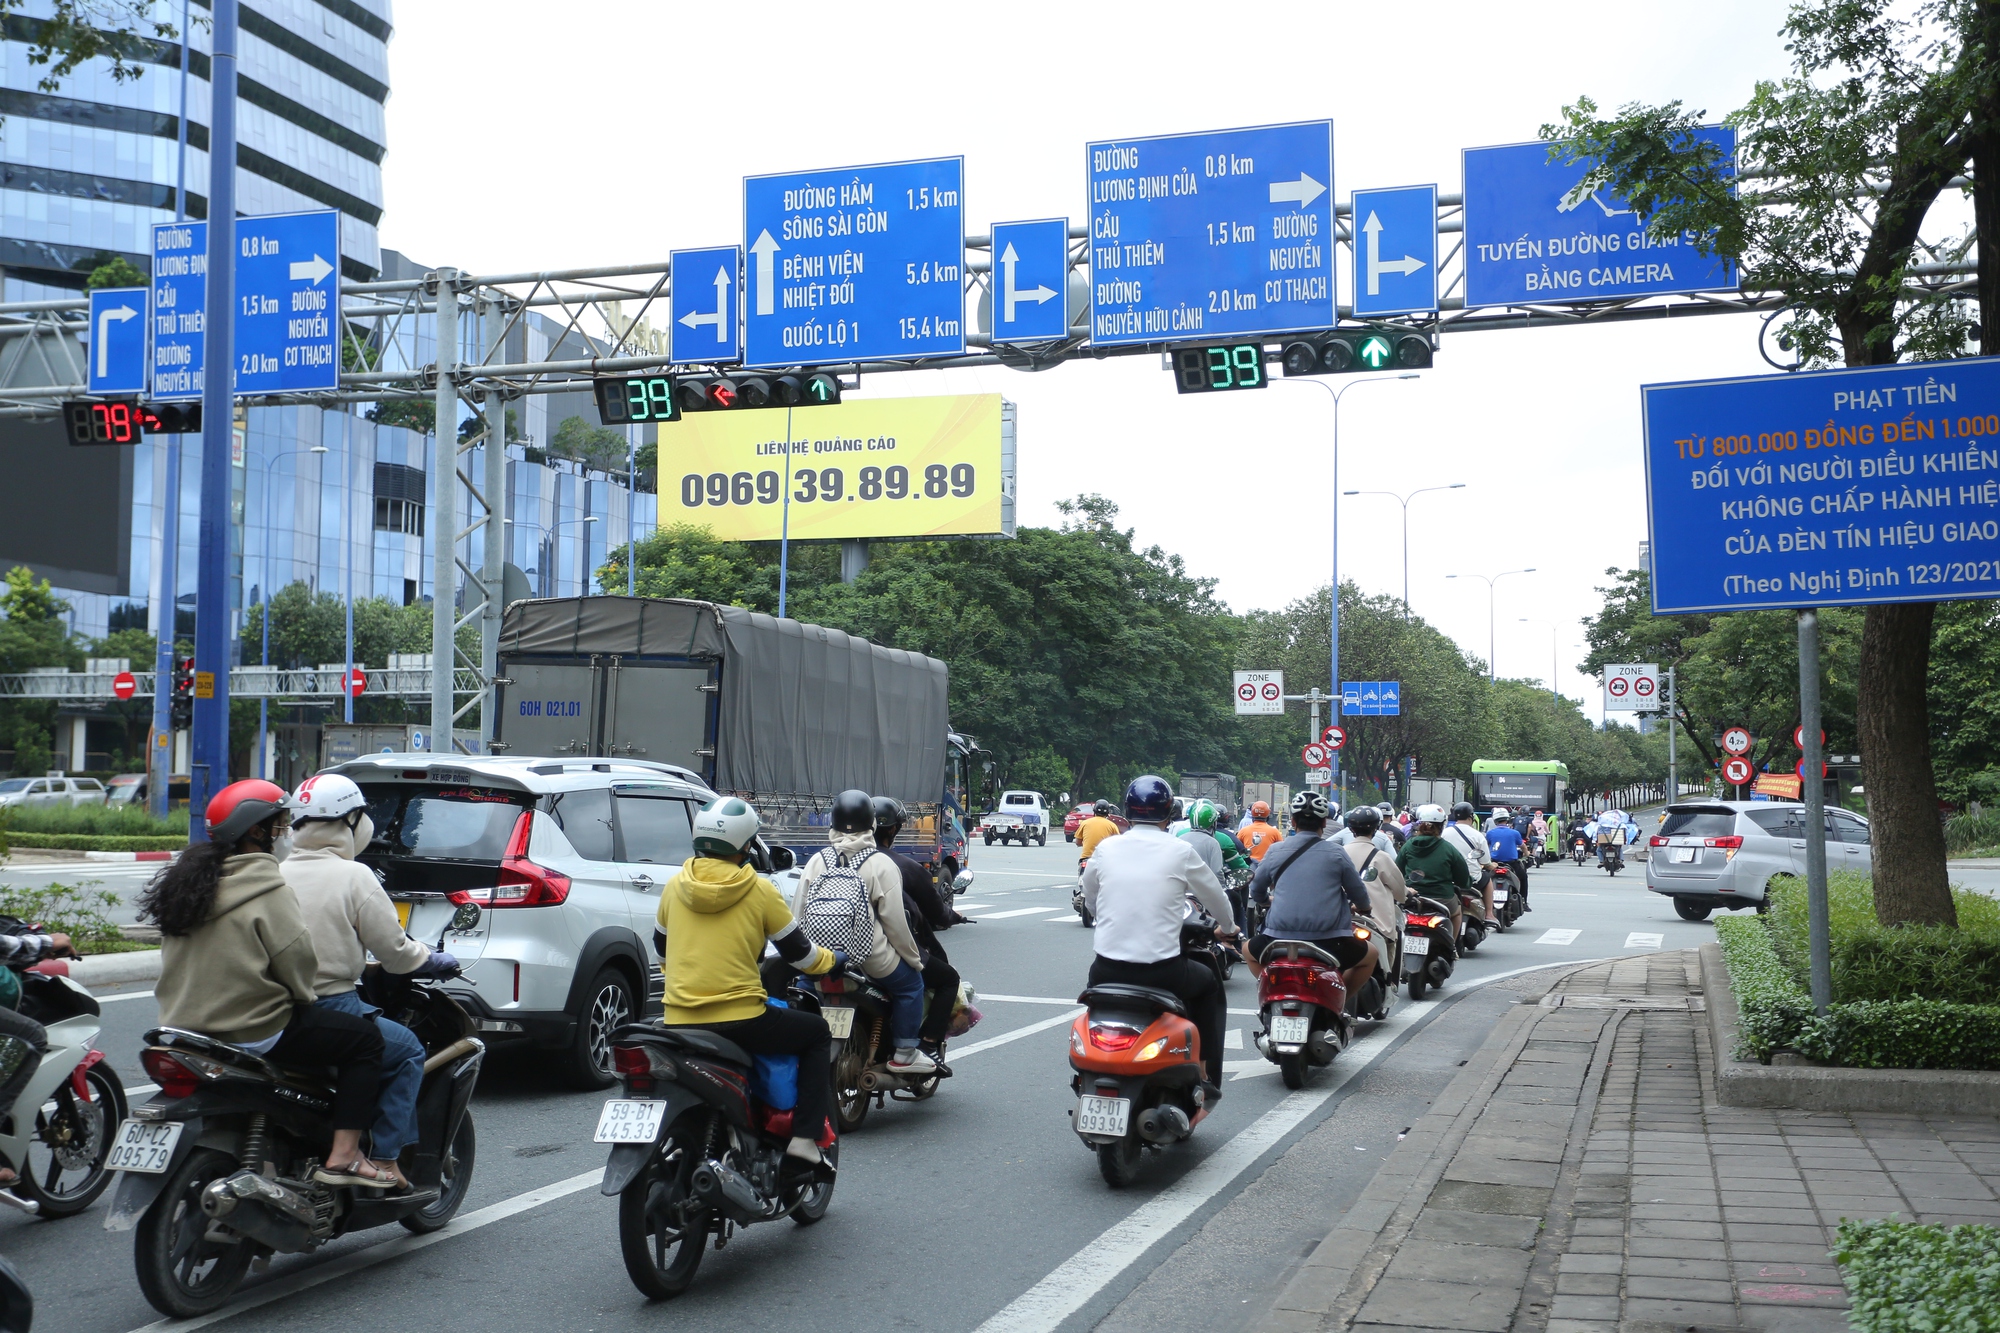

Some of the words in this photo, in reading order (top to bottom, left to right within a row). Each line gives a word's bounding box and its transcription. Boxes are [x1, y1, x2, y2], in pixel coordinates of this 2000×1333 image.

[1094, 146, 1138, 173] ĐƯỜNG
[1204, 154, 1227, 179] 0,8
[1230, 153, 1254, 176] km
[783, 183, 836, 212] ĐƯỜNG
[840, 176, 874, 207] HẦM
[906, 188, 930, 211] 1,5
[932, 187, 958, 208] km
[1094, 178, 1136, 204] LƯƠNG
[1138, 174, 1169, 202] ĐỊNH
[1172, 167, 1198, 197] CỦA
[782, 212, 823, 240] SÔNG
[828, 210, 852, 237] SÀI
[856, 208, 888, 235] GÒN
[1095, 209, 1120, 240] CẦU
[1206, 222, 1229, 247] 1,5
[1232, 222, 1256, 244] km
[1272, 210, 1318, 240] ĐƯỜNG
[157, 225, 192, 250] ĐƯỜNG
[242, 236, 259, 257] 0,8
[260, 236, 279, 255] km
[1096, 240, 1121, 270] THỦ
[1124, 238, 1164, 267] THIÊM
[1269, 240, 1321, 271] NGUYỄN
[1477, 233, 1542, 262] TUYẾN
[1548, 232, 1620, 257] ĐƯỜNG
[156, 255, 189, 278] LƯƠNG
[190, 254, 207, 276] ĐỊN
[783, 254, 824, 282] BỆNH
[828, 250, 864, 278] VIỆN
[906, 262, 930, 285] 5,6
[932, 262, 958, 284] km
[1525, 264, 1582, 292] BẰNG
[1588, 262, 1674, 286] CAMERA
[156, 281, 176, 308] CẦU
[242, 296, 259, 316] 1,5
[260, 296, 279, 314] km
[291, 286, 327, 312] ĐƯỜNG
[783, 283, 826, 310] NHIỆT
[828, 277, 854, 305] ĐỚI
[1096, 276, 1142, 306] ĐƯỜNG
[1208, 290, 1230, 315] 2,0
[1233, 290, 1257, 312] km
[1264, 280, 1283, 304] CƠ
[1285, 276, 1327, 305] THẠCH
[156, 310, 176, 335] THỦ
[178, 309, 206, 334] THIÊ
[288, 312, 328, 340] NGUYỄN
[782, 318, 823, 348] QUỐC
[828, 320, 848, 348] LỘ
[852, 322, 859, 343] 1
[898, 318, 931, 340] 15,4
[932, 316, 959, 338] km
[1096, 302, 1142, 336] NGUYỄN
[1146, 304, 1169, 334] HỮU
[1172, 302, 1203, 331] CẢNH
[156, 340, 192, 366] ĐƯỜNG
[242, 354, 259, 375] 2,0
[260, 354, 278, 372] km
[284, 348, 299, 367] CƠ
[300, 344, 332, 368] THẠCH
[1207, 346, 1260, 388] 39
[156, 366, 191, 393] NGUYỄN
[1834, 388, 1896, 412] PHẠT
[1901, 376, 1957, 405] TIỀN
[626, 378, 672, 420] 39
[92, 403, 132, 442] 79
[1674, 433, 1706, 460] TỪ
[1712, 430, 1798, 457] 800.000
[1804, 418, 1875, 449] ĐỒNG
[1882, 412, 1935, 442] ĐẾN
[756, 440, 786, 456] LIÊN
[792, 438, 810, 457] HỆ
[814, 436, 863, 455] QUẢNG
[867, 436, 896, 450] CÁO
[1692, 460, 1730, 490] ĐỐI
[1735, 459, 1773, 486] VỚI
[1780, 454, 1852, 484] NGƯỜI
[1860, 448, 1916, 478] ĐIỀU
[1923, 440, 1999, 474] KHIỂN
[1722, 496, 1803, 521] KHÔNG
[1810, 485, 1875, 515] CHẤP
[1882, 484, 1951, 511] HÀNH
[1958, 480, 2000, 506] HIỆ
[1725, 528, 1772, 556] CỦA
[1778, 527, 1826, 552] ĐÈN
[1832, 523, 1872, 549] TÍN
[1879, 520, 1935, 549] HIỆU
[1942, 520, 1999, 542] GIAO
[1723, 575, 1783, 598] (Theo
[1790, 570, 1842, 596] Nghị
[1848, 566, 1900, 590] Định
[1248, 674, 1270, 682] ZONE
[1619, 667, 1644, 676] ZONE
[520, 700, 542, 717] 60H
[546, 701, 581, 717] 021.01
[440, 773, 452, 784] HỢP
[1276, 1030, 1302, 1040] 1703
[610, 1104, 654, 1120] 59-B1
[1080, 1114, 1124, 1132] 993.94
[1087, 1098, 1121, 1116] 43-D1
[600, 1122, 656, 1140] 445.33
[110, 1146, 168, 1168] 095.79
